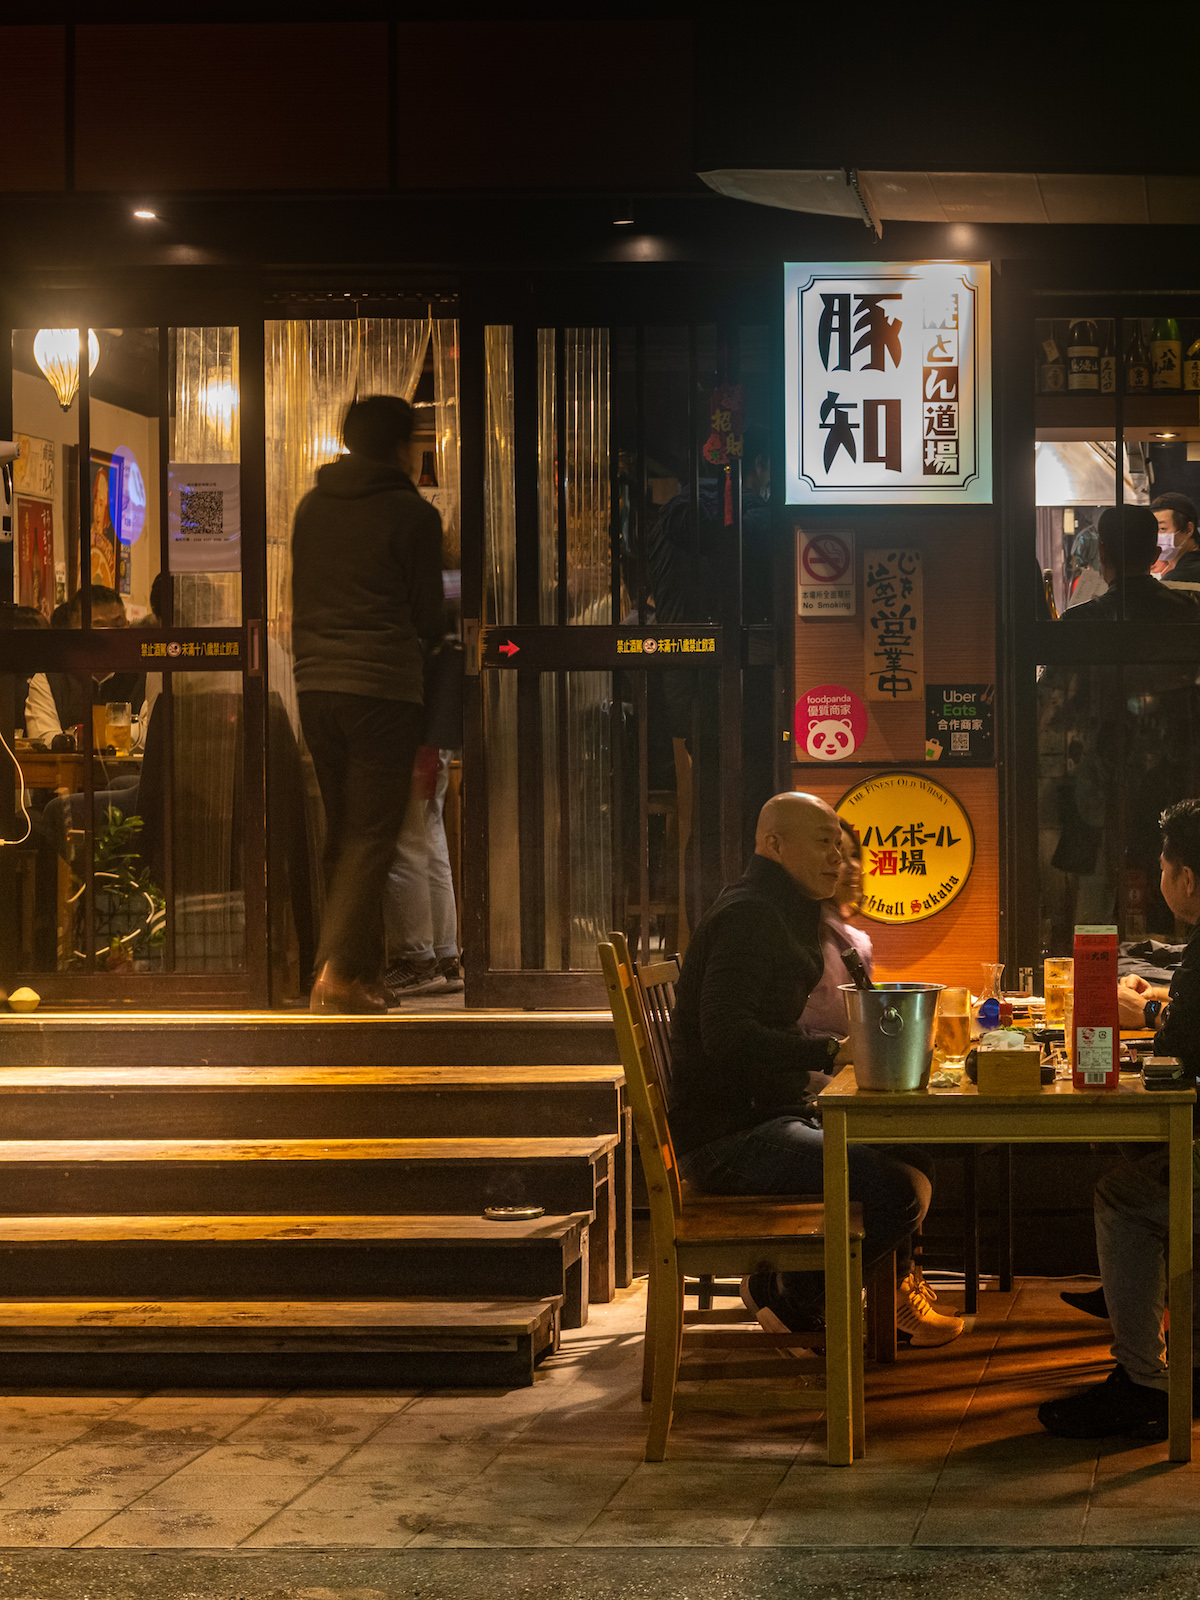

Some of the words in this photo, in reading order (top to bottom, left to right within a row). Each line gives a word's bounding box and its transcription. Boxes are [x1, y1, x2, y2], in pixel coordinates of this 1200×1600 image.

[1153, 348, 1177, 375] 八海山
[818, 293, 903, 475] 豚知
[922, 293, 960, 476] とん道場
[711, 408, 743, 456] 招財
[817, 601, 851, 610] Smoking
[807, 694, 852, 706] foodpanda
[942, 690, 976, 703] Uber
[943, 704, 977, 716] Eats
[807, 704, 852, 717] 優質商家
[937, 718, 983, 731] 合作商家
[848, 792, 866, 806] THE
[864, 780, 895, 794] FINEST
[897, 778, 916, 787] OLD
[868, 849, 927, 876] 酒場
[864, 893, 905, 917] hball
[910, 874, 960, 915] Sakaba
